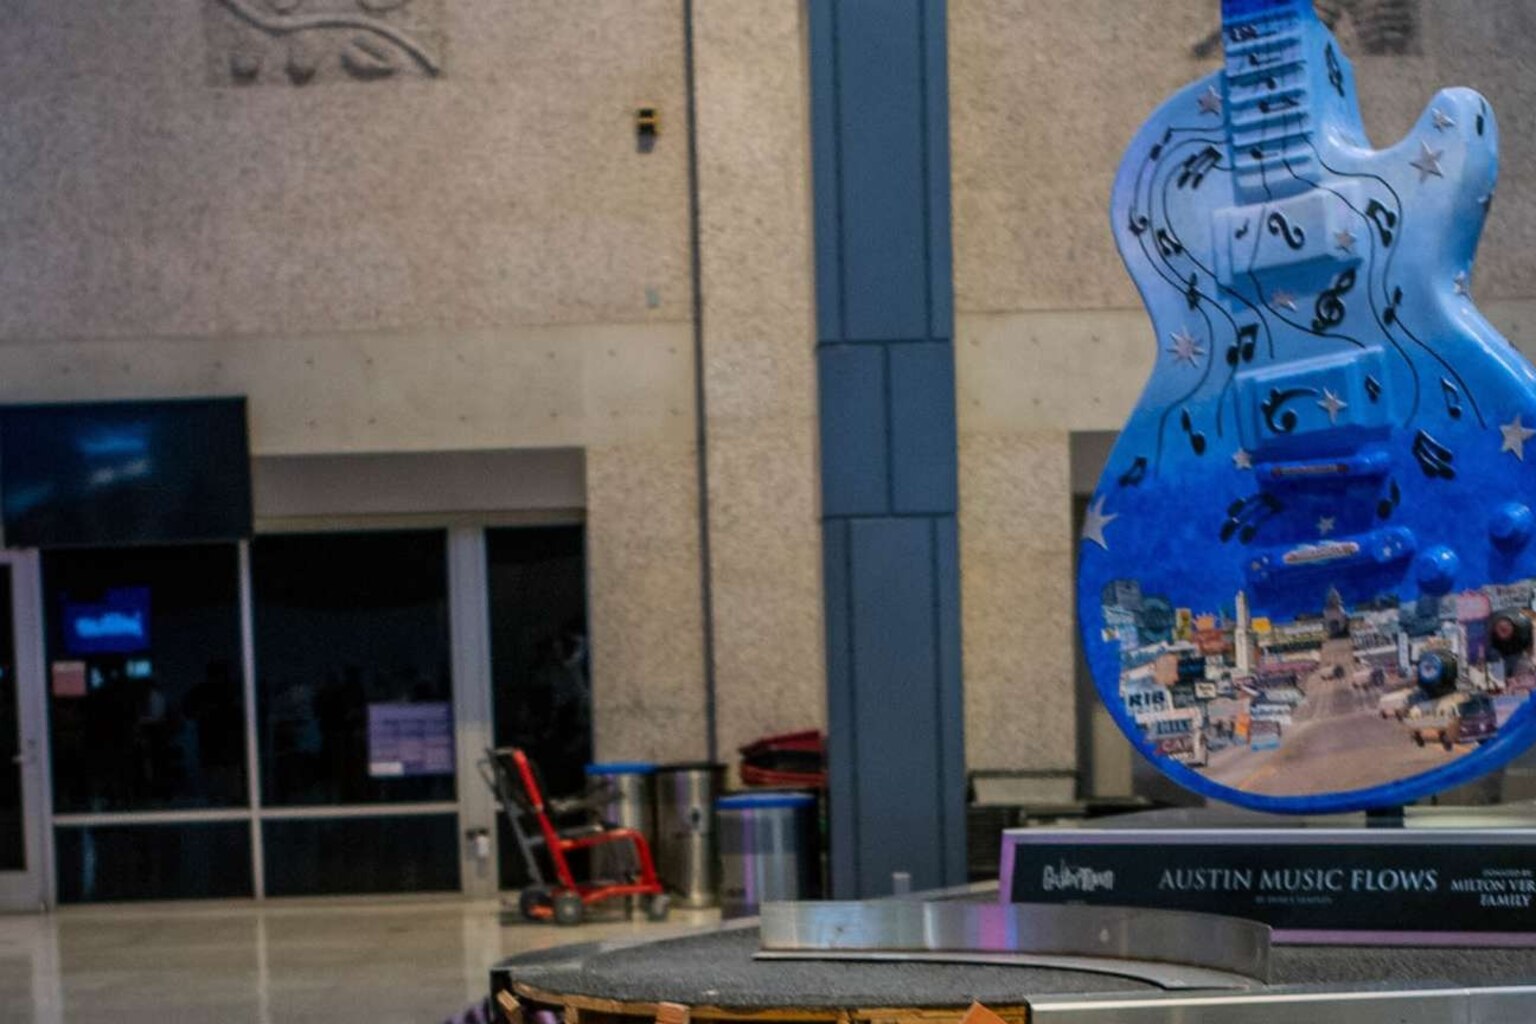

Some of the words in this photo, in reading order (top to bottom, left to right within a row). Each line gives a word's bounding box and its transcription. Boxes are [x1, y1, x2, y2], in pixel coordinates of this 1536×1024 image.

[1158, 868, 1252, 890] AUSTIN
[1258, 868, 1344, 891] MUSIC
[1351, 868, 1439, 891] FLOWS
[1450, 878, 1506, 892] MILTON
[1479, 893, 1533, 907] FAMILY
